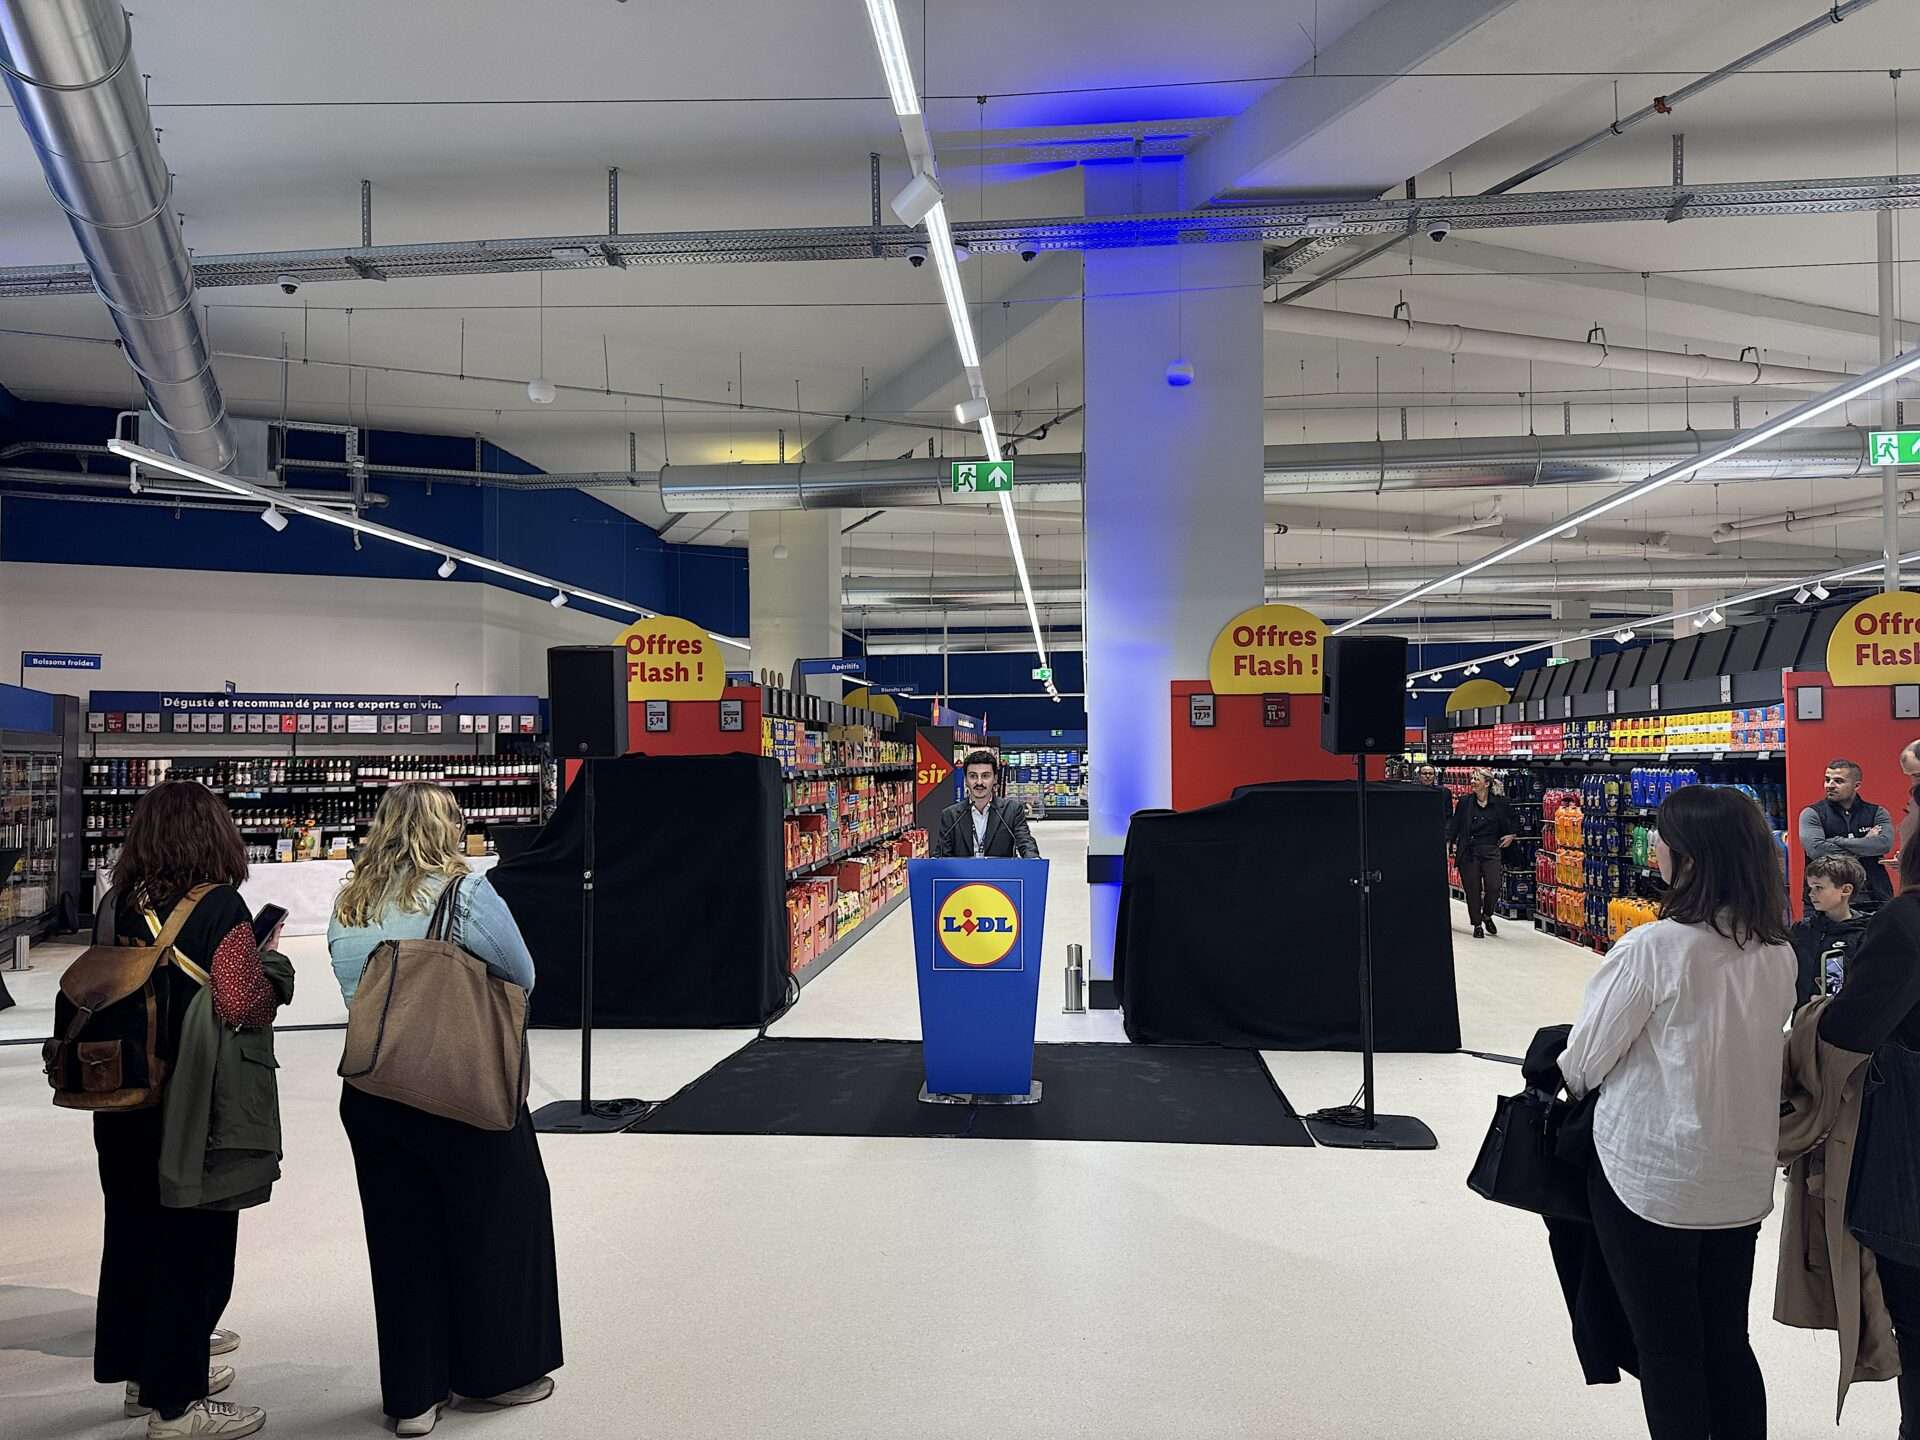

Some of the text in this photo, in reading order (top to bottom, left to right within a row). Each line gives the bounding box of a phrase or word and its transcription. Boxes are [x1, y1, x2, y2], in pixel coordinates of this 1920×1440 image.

[626, 634, 703, 655] Offres
[1233, 625, 1317, 648] Offres
[32, 658, 94, 667] Boissons froides
[626, 662, 703, 682] Flash !
[831, 663, 860, 671] Apéritifs
[1234, 653, 1319, 676] Flash !
[163, 697, 442, 711] Dégusté et recommandé par nos experts en vin.
[943, 908, 1013, 936] LIDL
